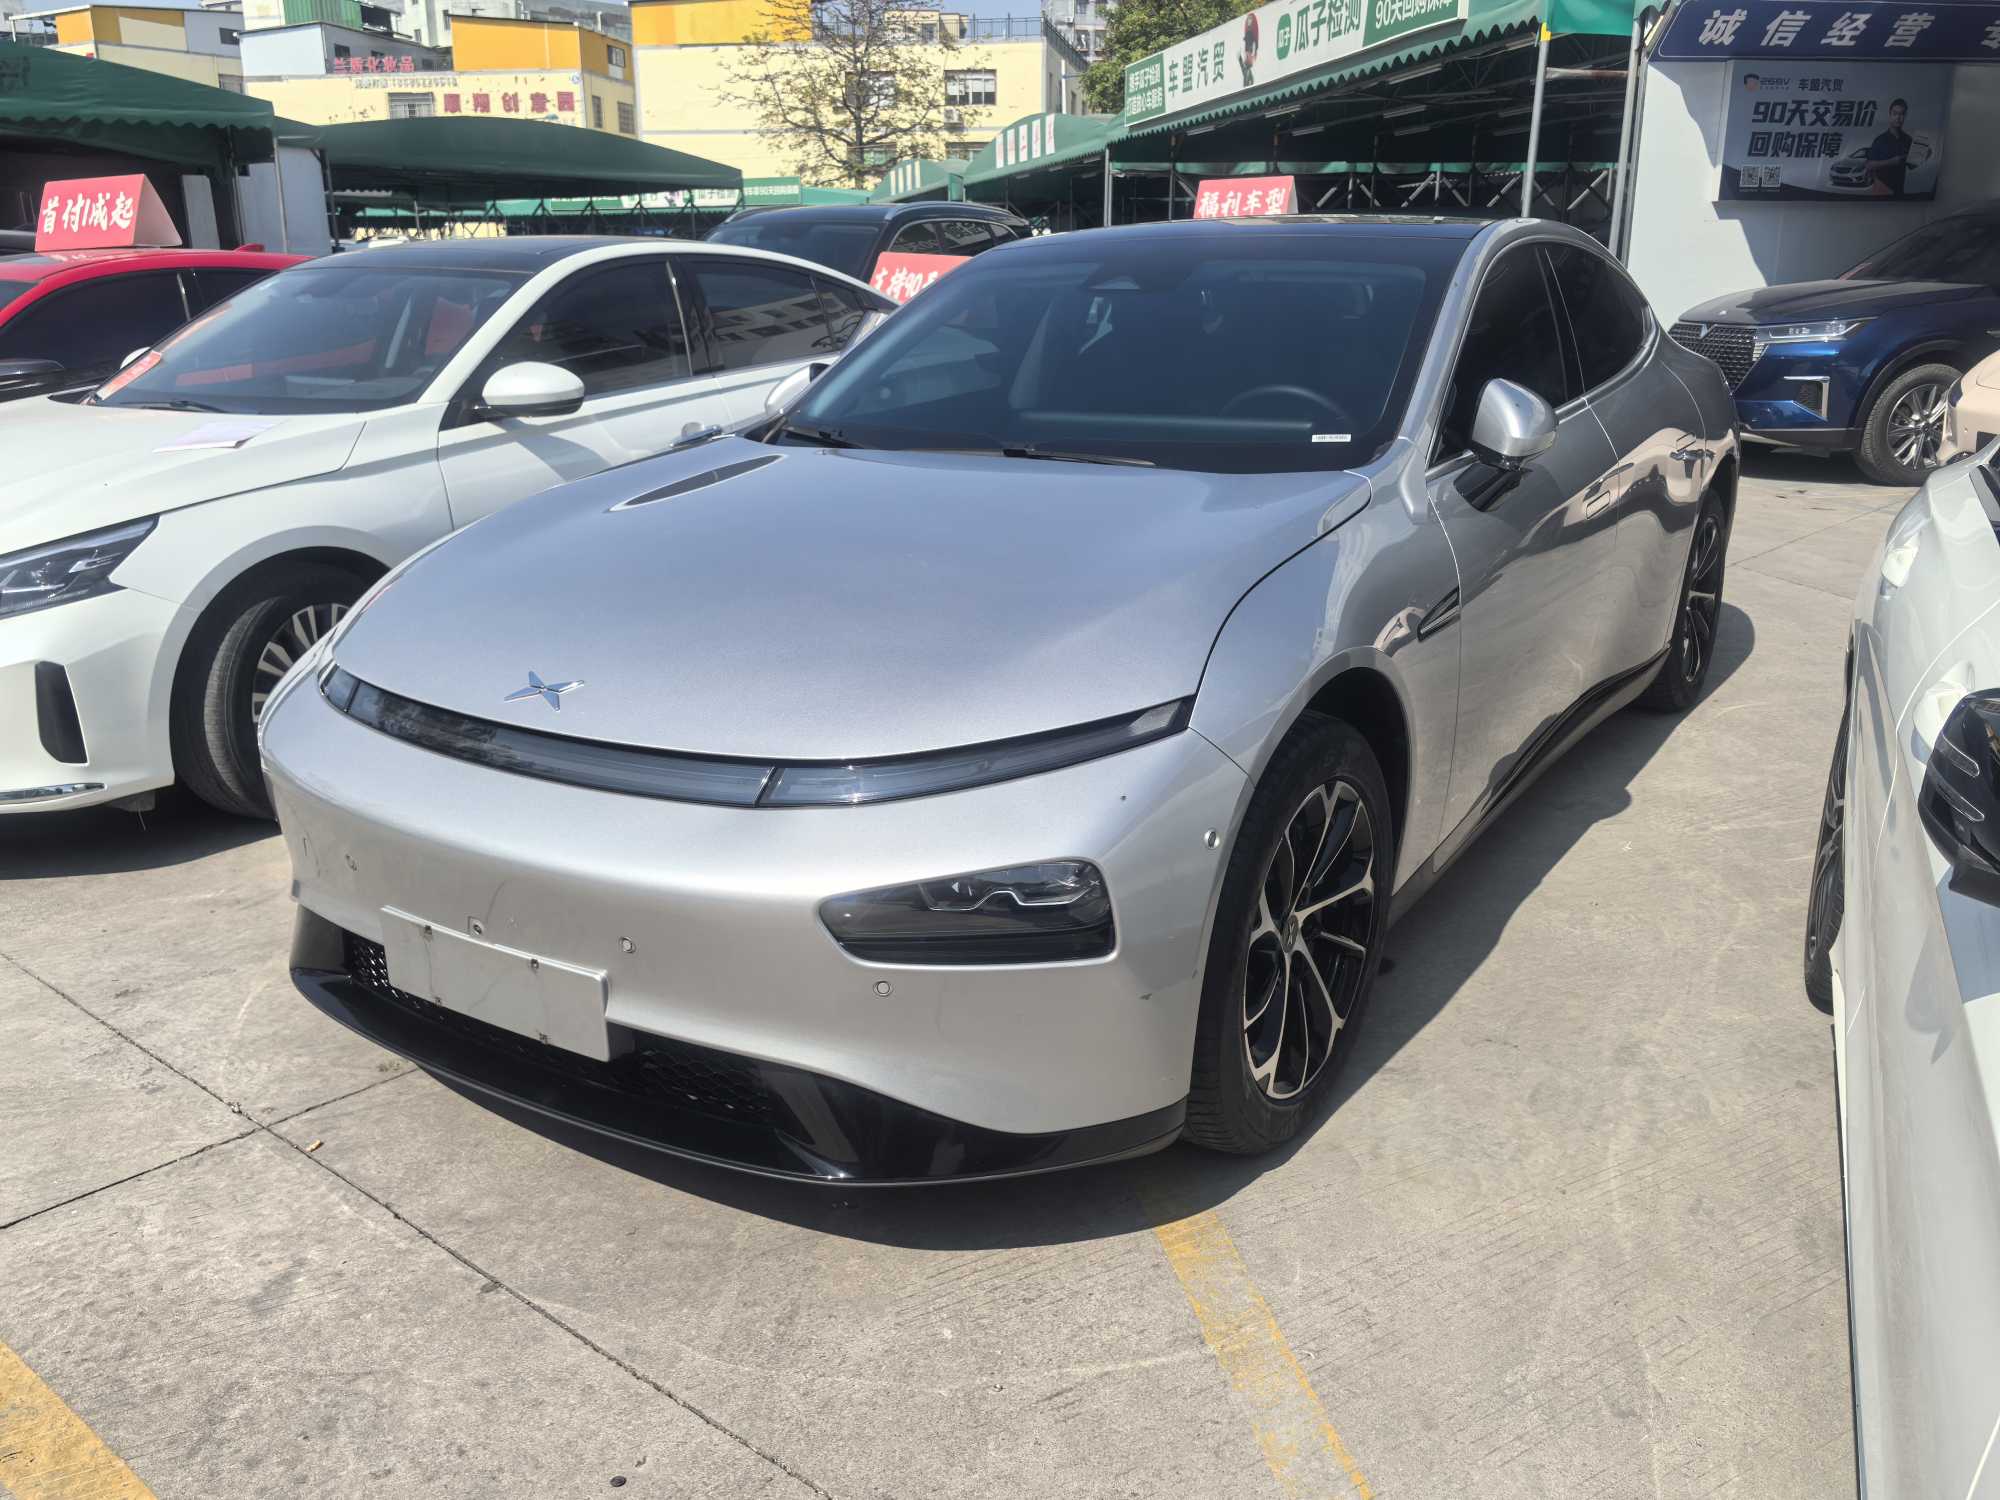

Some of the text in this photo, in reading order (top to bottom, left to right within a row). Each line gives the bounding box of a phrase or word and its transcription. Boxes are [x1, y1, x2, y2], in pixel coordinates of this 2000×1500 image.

[1295, 0, 1361, 53] 瓜子检测
[1375, 0, 1453, 29] 90天回购
[1699, 9, 1935, 48] 诚信经营
[1168, 40, 1225, 97] 车盟汽贸
[1798, 78, 1844, 92] 车盟汽贸
[1751, 100, 1878, 127] 90天交易价
[1747, 131, 1843, 159] 回购保障
[42, 191, 135, 234] 首付1成起
[1199, 187, 1286, 217] 福利车型
